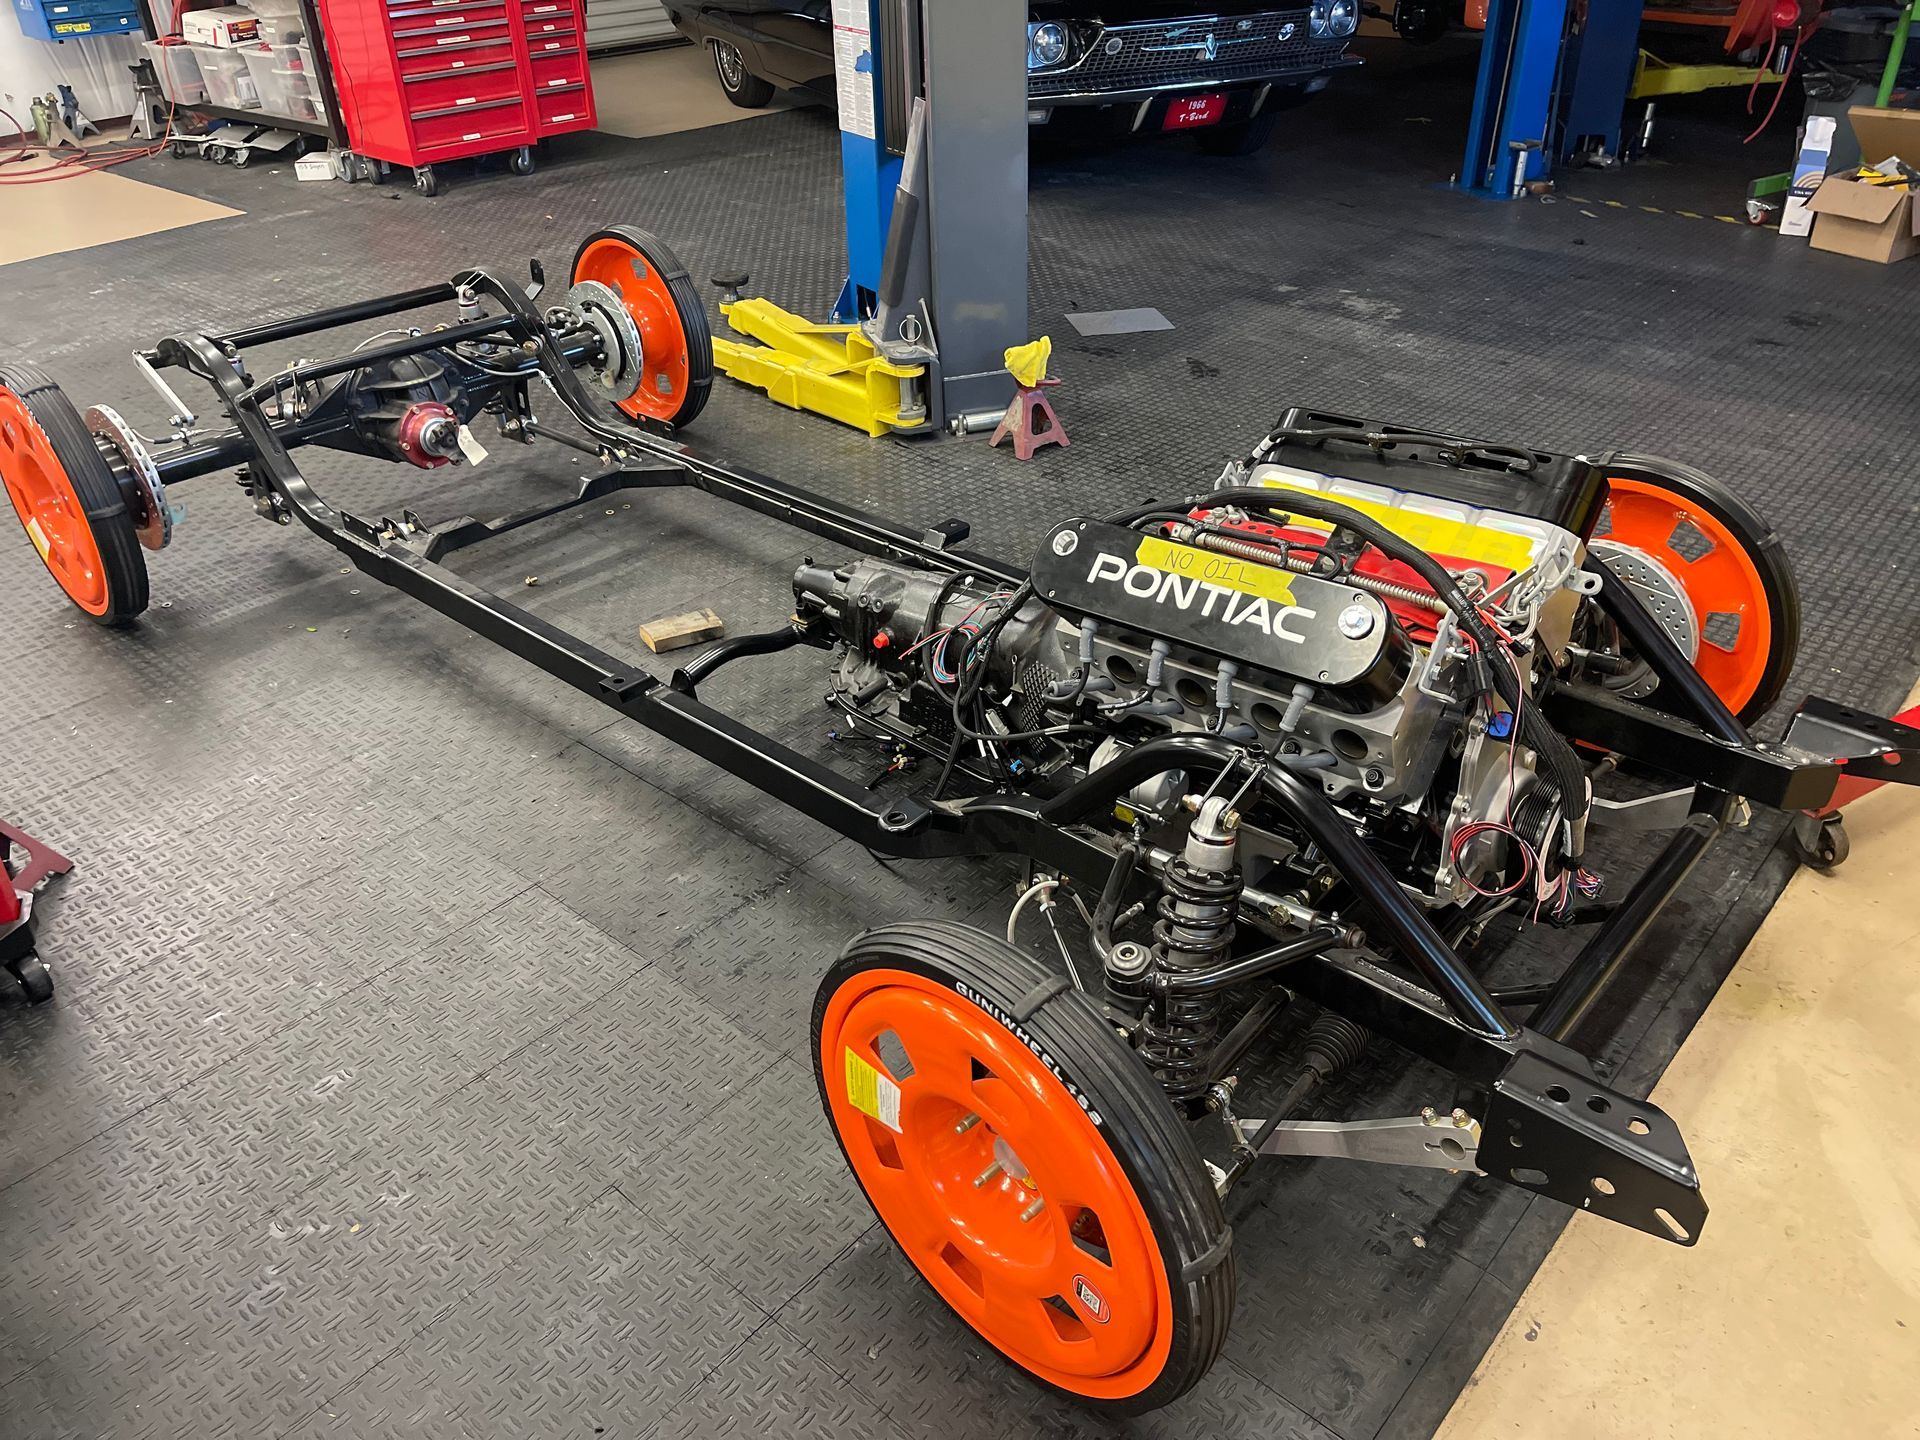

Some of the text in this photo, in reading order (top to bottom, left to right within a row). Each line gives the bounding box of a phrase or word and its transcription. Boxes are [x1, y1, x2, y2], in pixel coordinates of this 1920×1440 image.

[1179, 111, 1210, 122] T-Bird
[1188, 100, 1207, 110] 1966
[1164, 548, 1257, 587] NO OIL
[1086, 552, 1317, 644] PONTIAC
